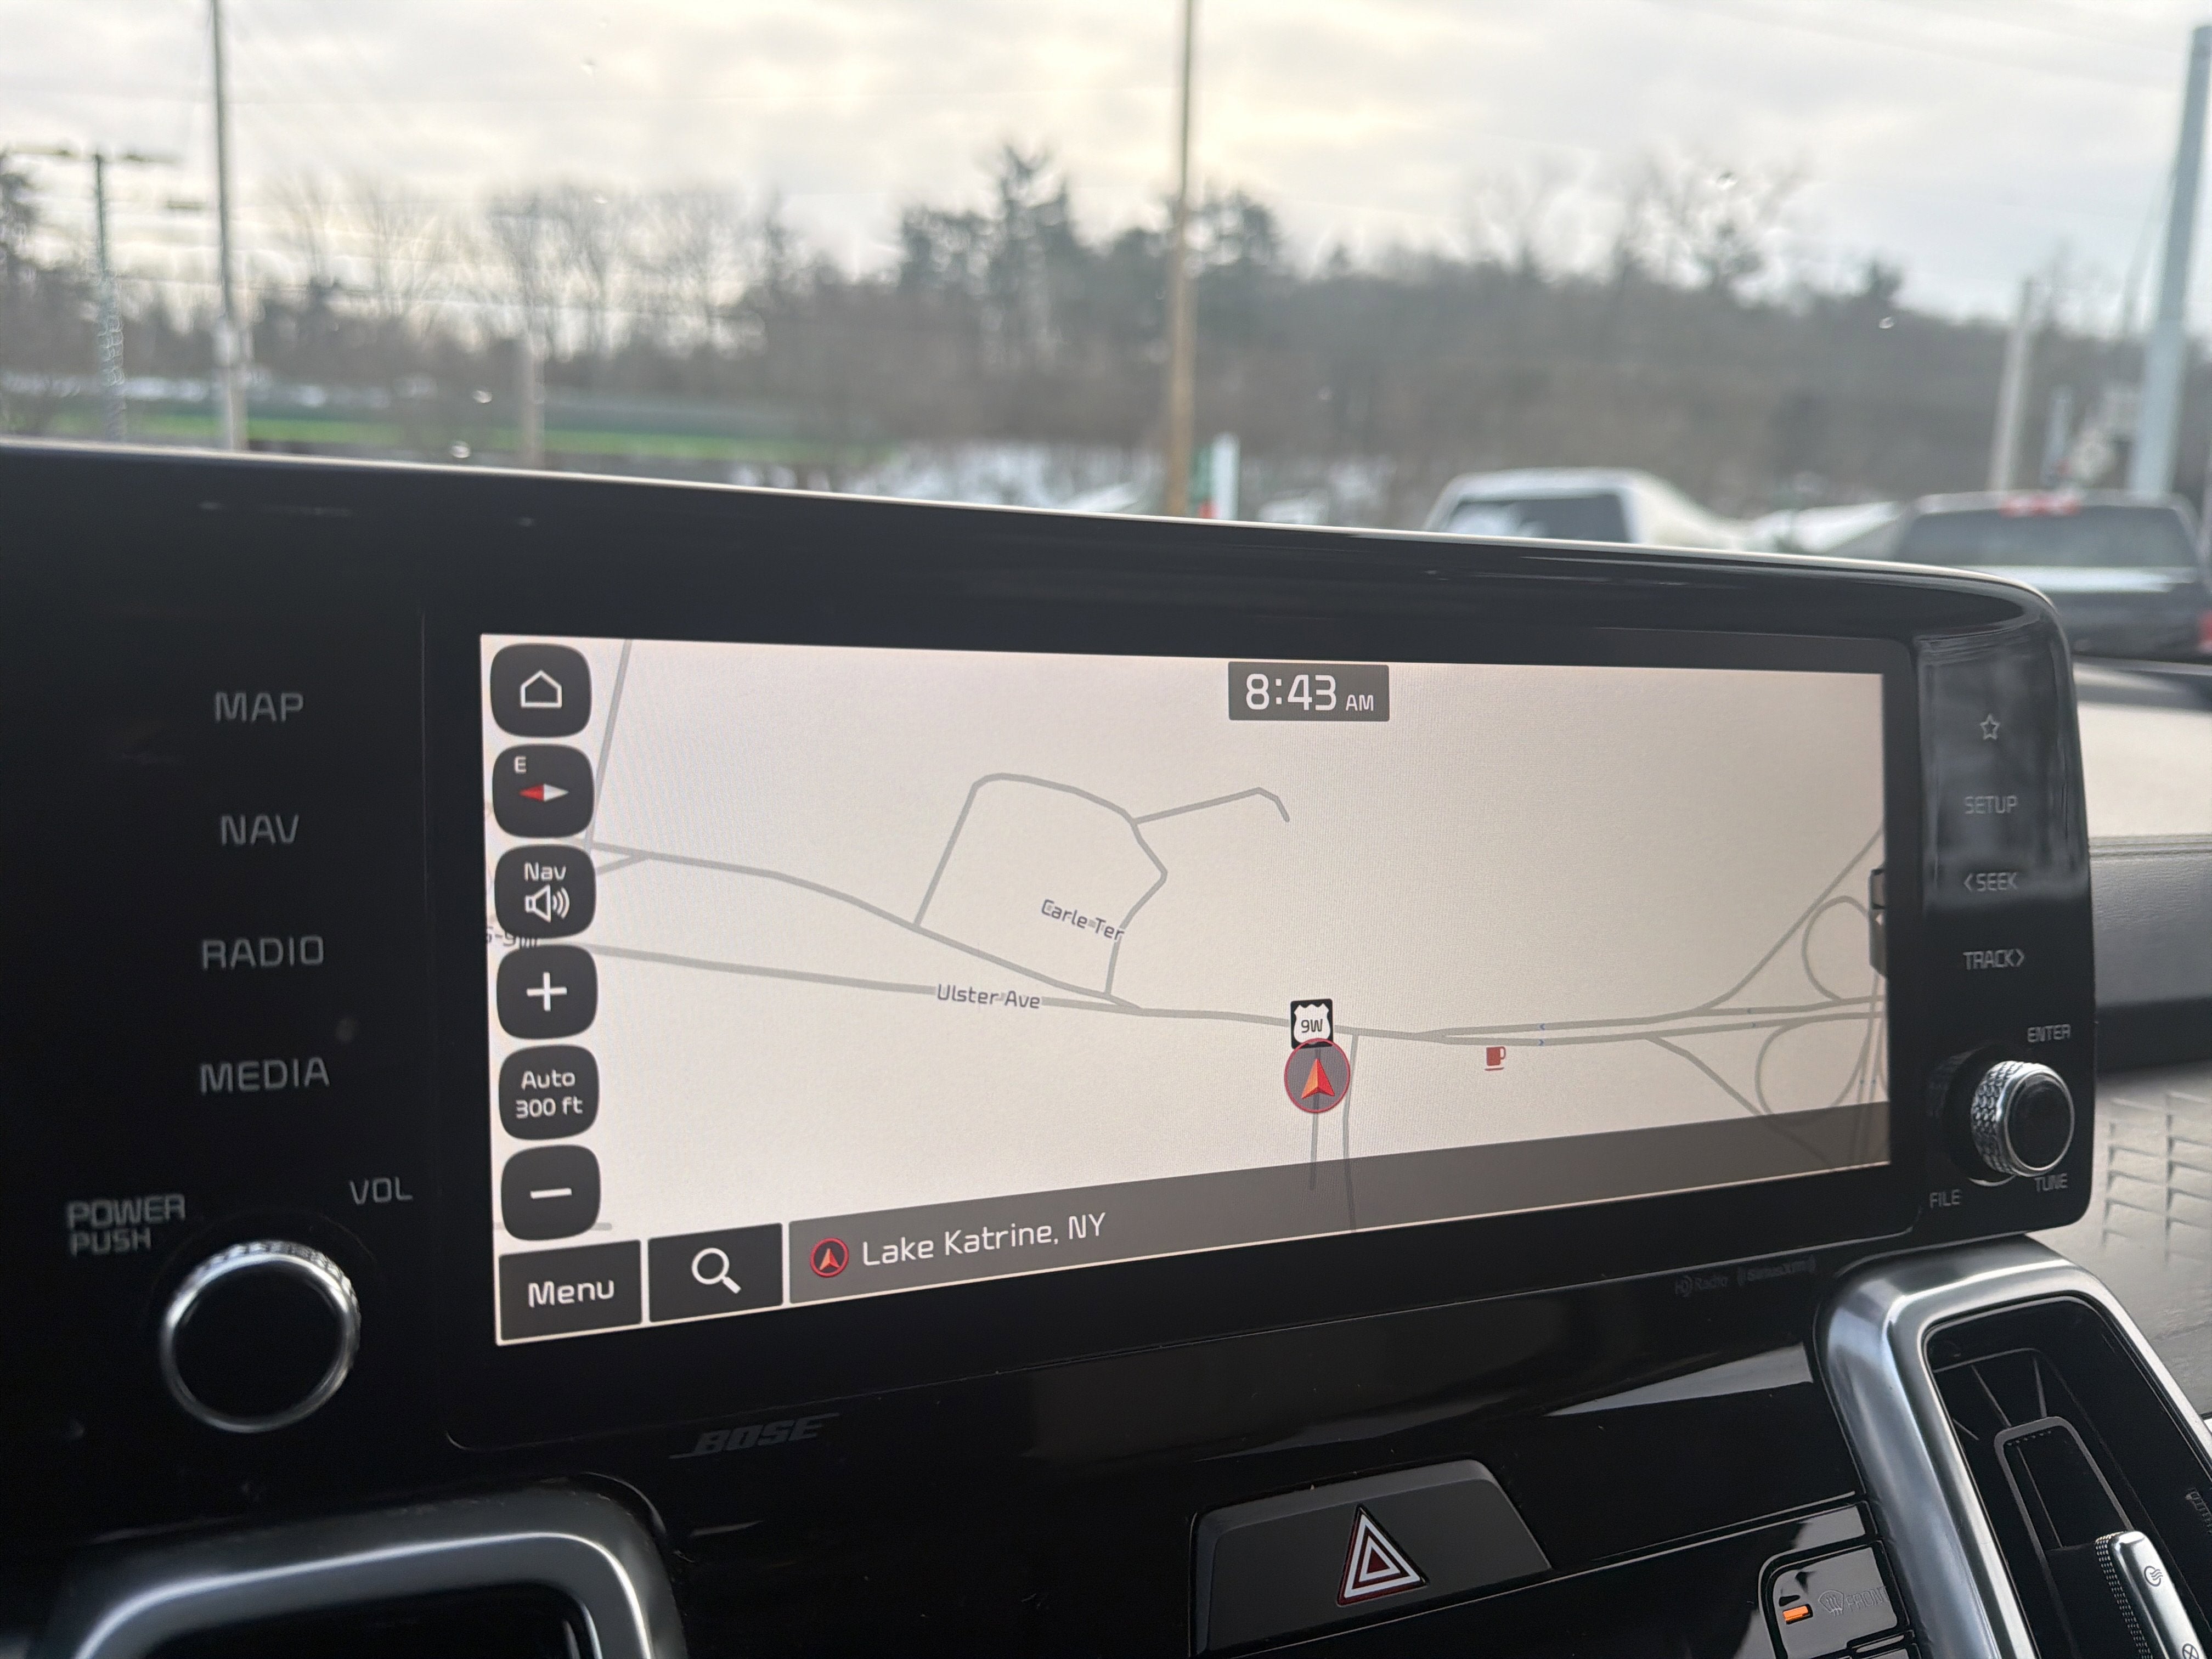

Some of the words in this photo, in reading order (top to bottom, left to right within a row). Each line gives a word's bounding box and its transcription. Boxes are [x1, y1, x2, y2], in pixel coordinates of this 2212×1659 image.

[1246, 674, 1336, 710] 8:43
[1346, 695, 1374, 712] AM
[214, 692, 304, 723] MAP
[514, 756, 527, 774] E
[1965, 795, 2018, 814] SETUP
[221, 814, 300, 845] NAV
[524, 862, 567, 881] Nav
[1977, 872, 2018, 891] SEEK
[1041, 899, 1088, 929] Carle
[1095, 917, 1125, 940] Ter
[202, 935, 324, 970] RADIO
[1963, 950, 2011, 970] TRACK
[937, 983, 999, 1005] Ulster
[1005, 990, 1040, 1009] Ave
[1301, 1019, 1323, 1034] 9W
[2027, 1024, 2071, 1042] ENTER
[200, 1057, 329, 1094] MEDIA
[522, 1069, 576, 1091] Auto
[515, 1098, 556, 1119] 300
[562, 1095, 583, 1116] ft
[349, 1177, 413, 1205] VOL
[2034, 1173, 2068, 1192] TUNE
[67, 1193, 186, 1229] POWER
[1929, 1188, 1961, 1208] FILE
[70, 1227, 151, 1256] PUSH
[862, 1237, 934, 1266] Lake
[945, 1223, 1059, 1256] Katrine,
[1069, 1212, 1106, 1240] NY
[528, 1279, 615, 1308] Menu
[668, 1412, 840, 1460] BOSE
